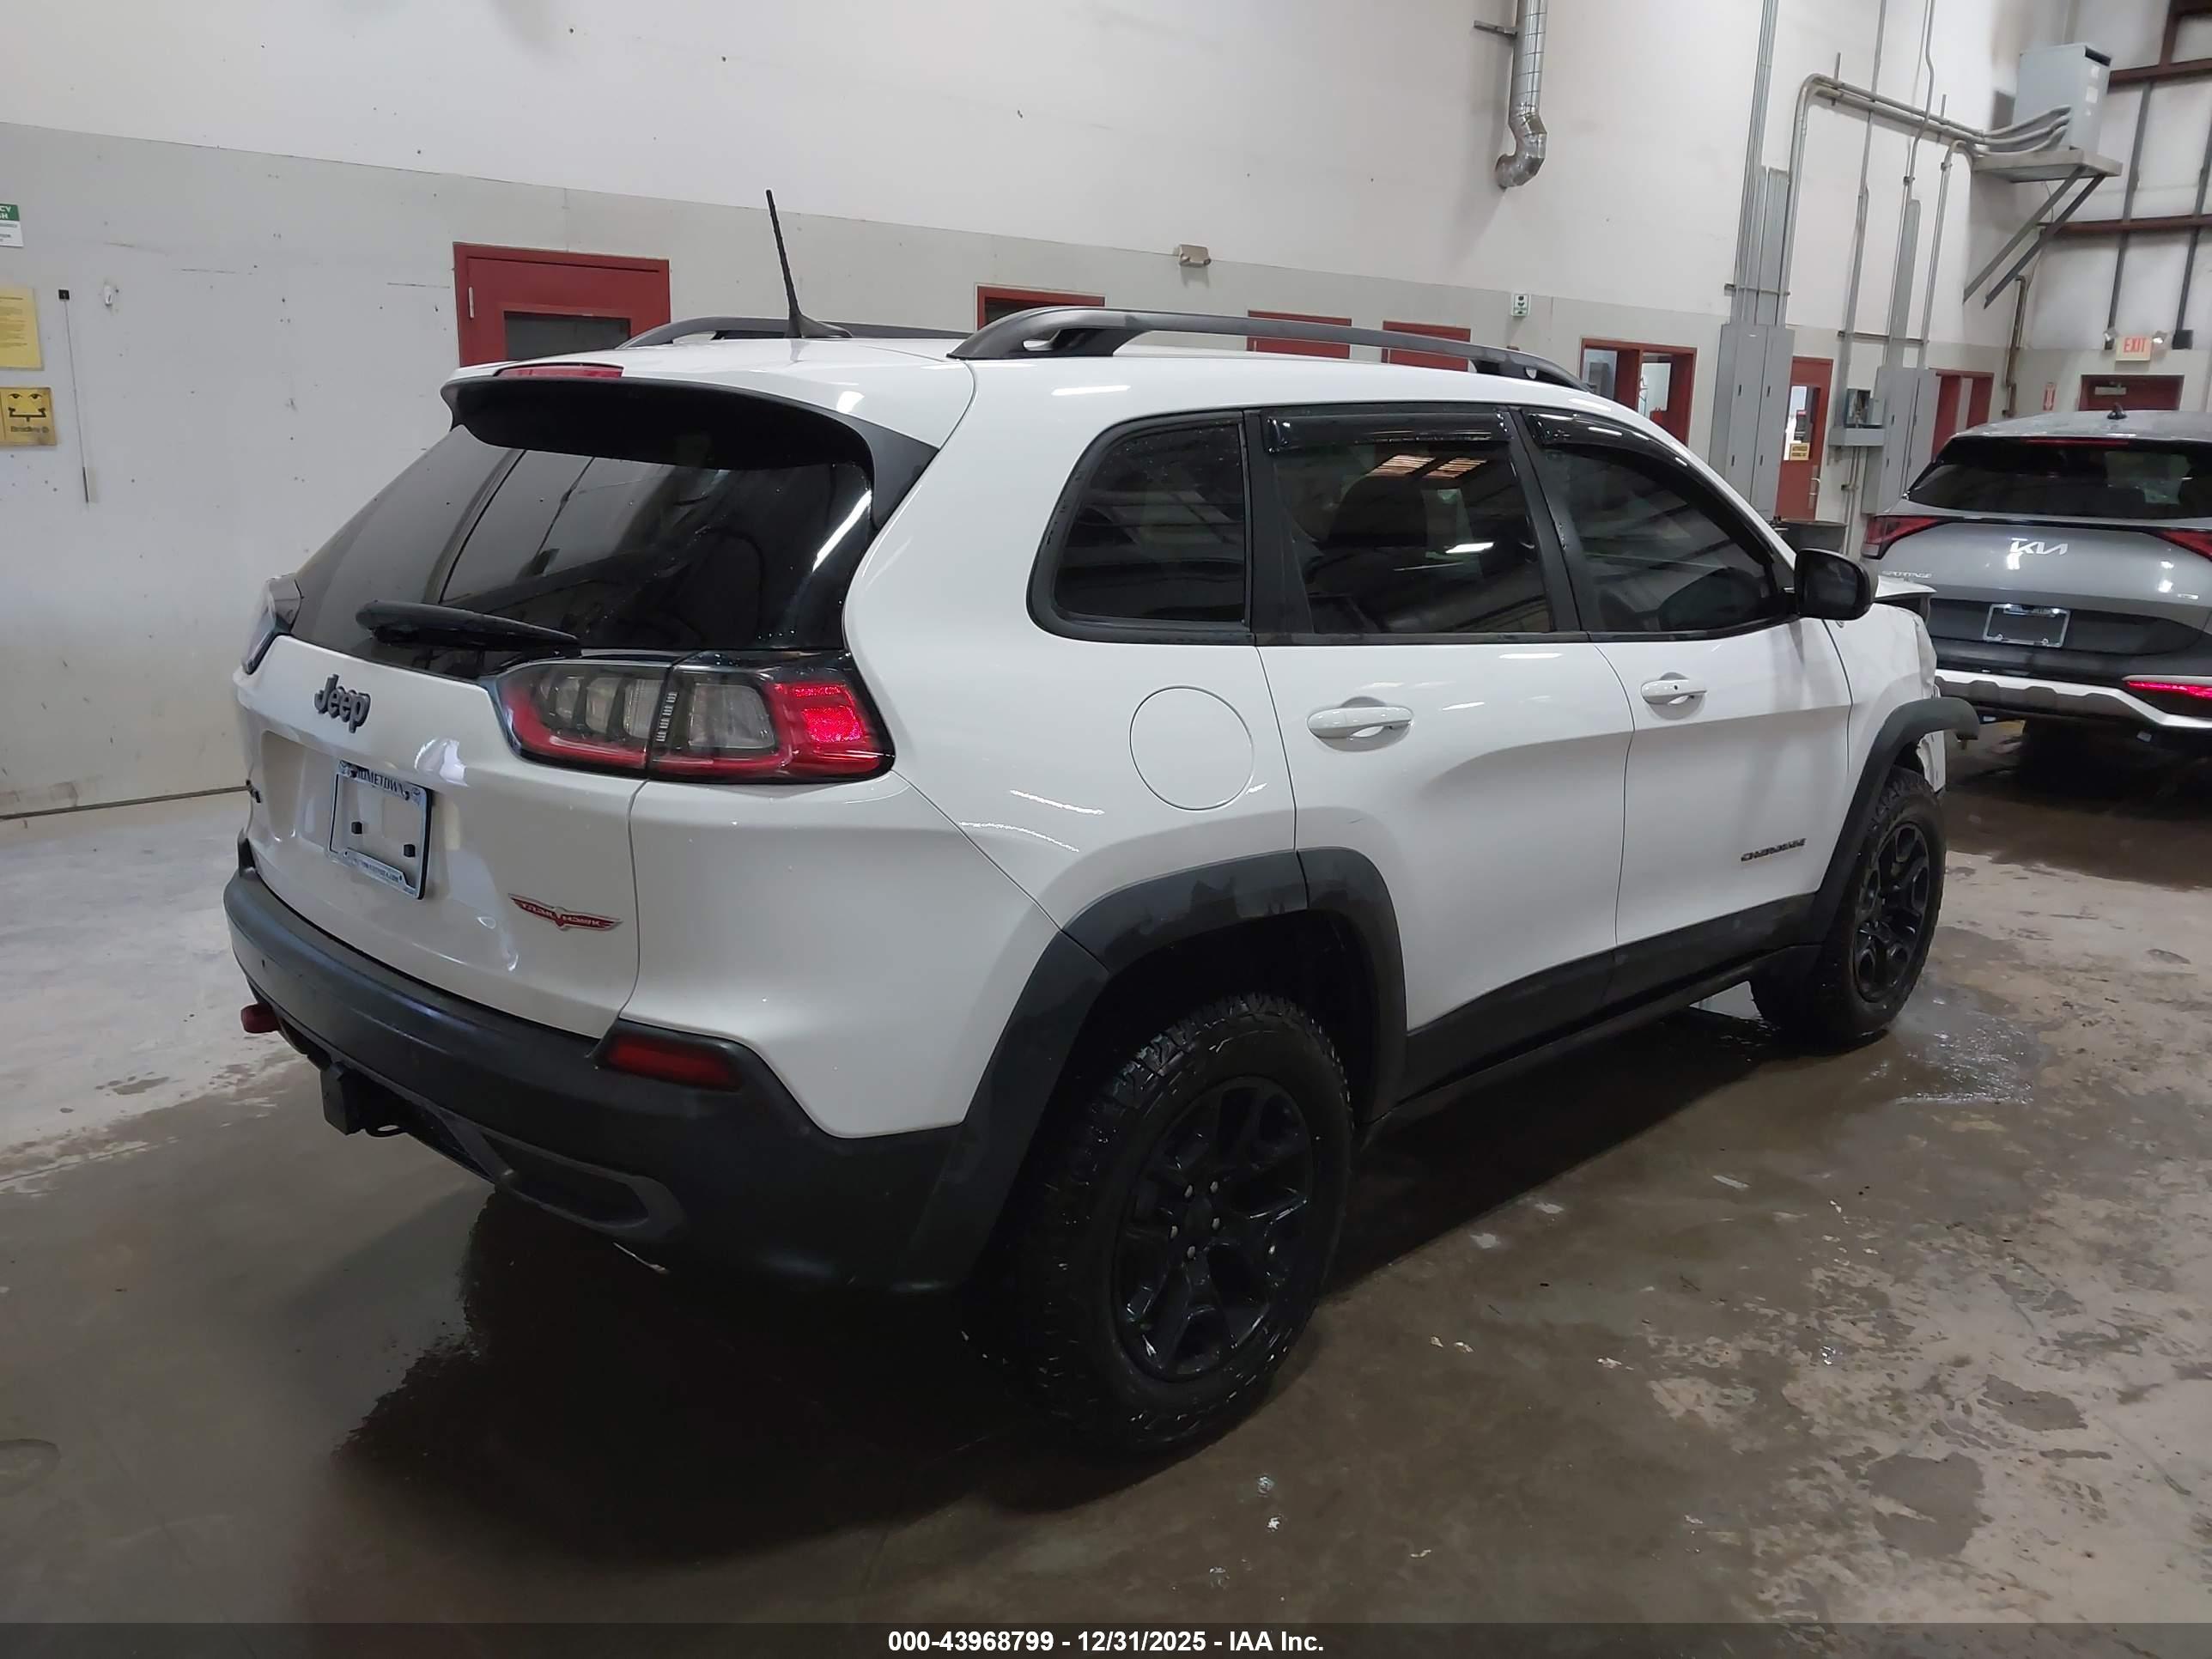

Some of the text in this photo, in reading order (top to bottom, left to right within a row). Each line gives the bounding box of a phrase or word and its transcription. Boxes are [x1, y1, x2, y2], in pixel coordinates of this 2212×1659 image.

[2124, 337, 2148, 353] EXIT
[2010, 538, 2069, 556] KIA
[314, 673, 371, 734] Jeep
[357, 768, 406, 799] HOMETOWN
